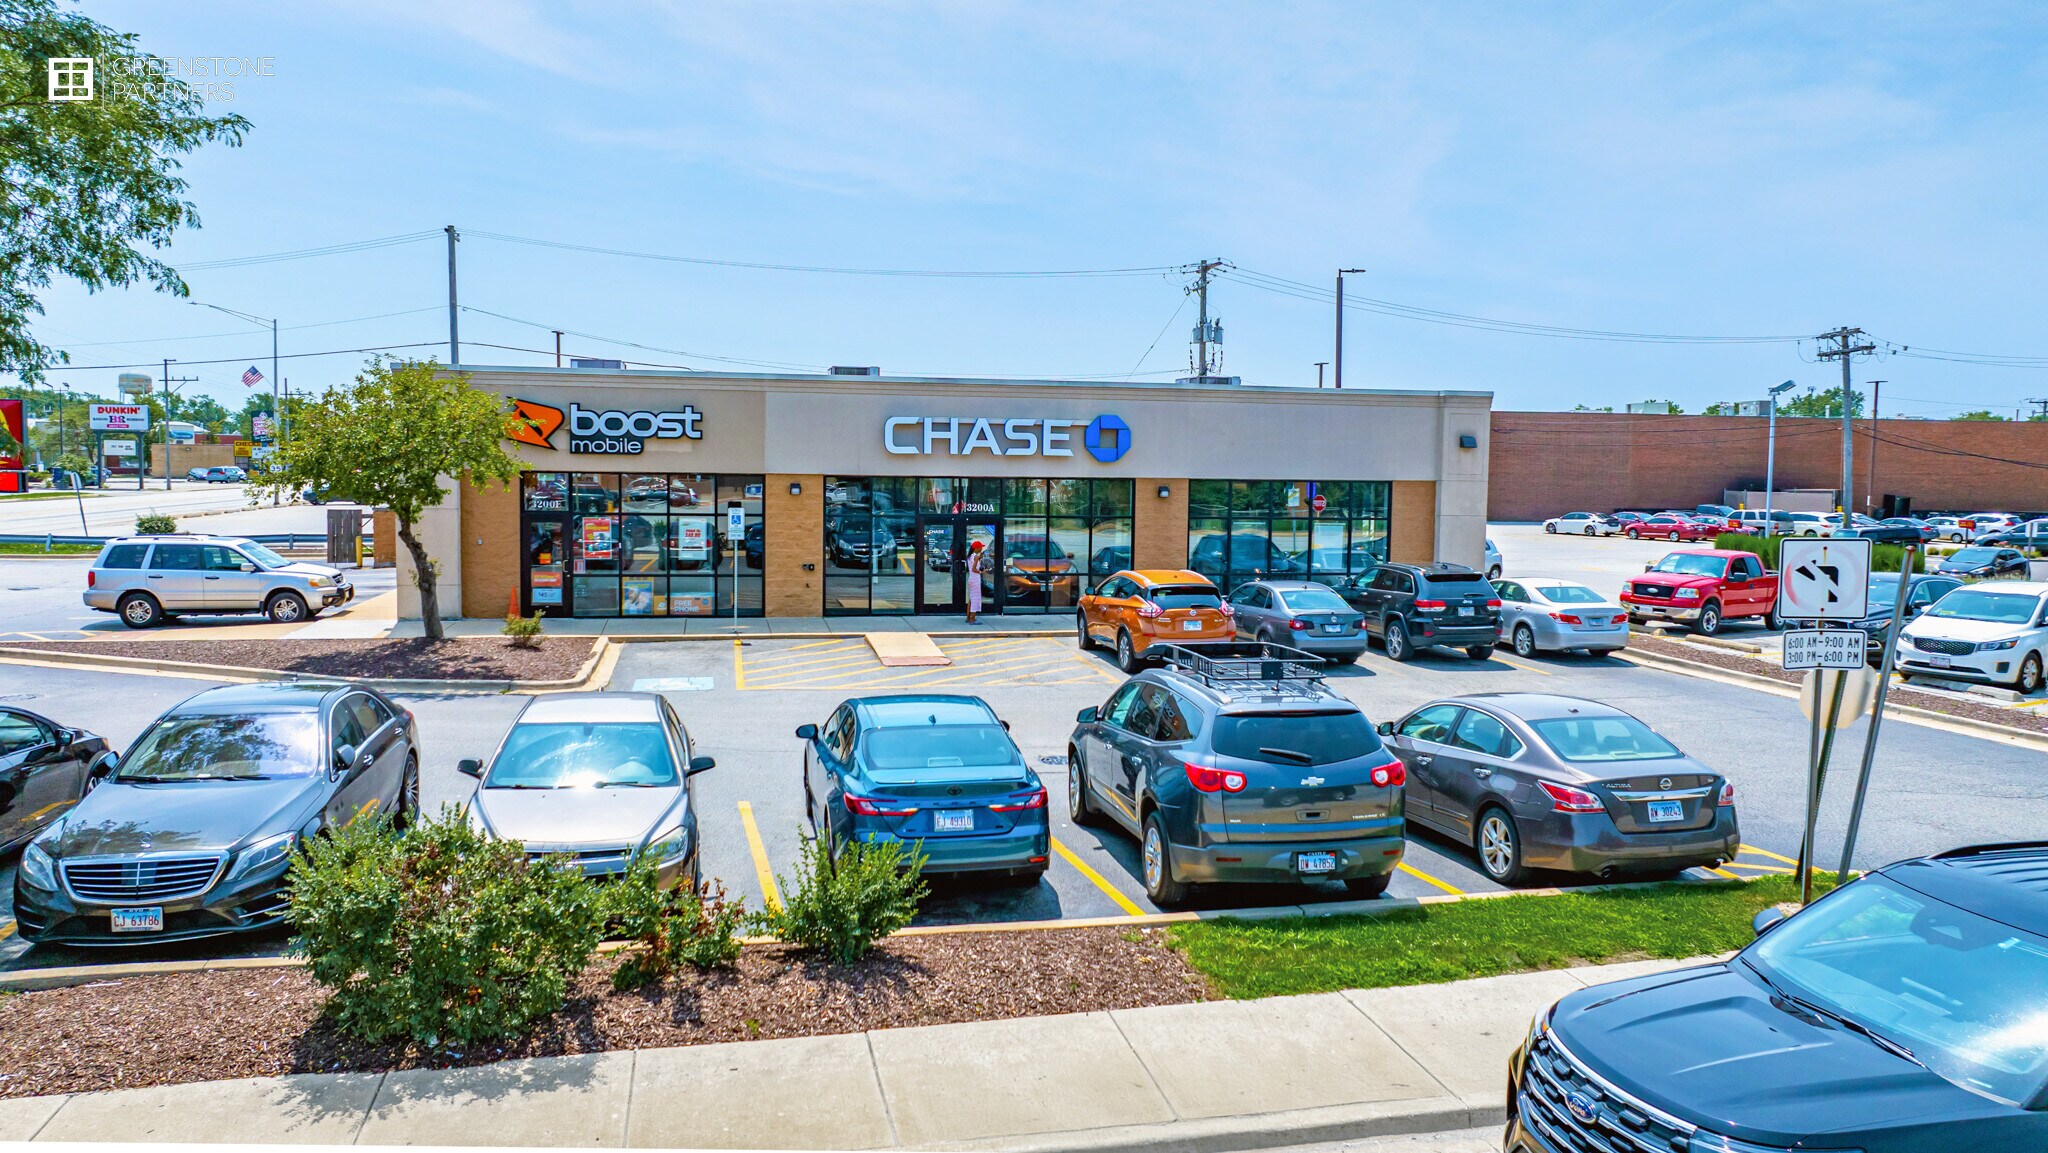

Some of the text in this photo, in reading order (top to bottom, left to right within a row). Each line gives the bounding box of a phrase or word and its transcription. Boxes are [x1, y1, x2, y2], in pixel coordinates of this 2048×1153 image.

[97, 406, 140, 414] DUNKIN'
[570, 403, 702, 439] boost
[884, 416, 1075, 457] CHASE
[571, 438, 642, 453] mobile
[966, 503, 995, 512] 3200A
[1788, 637, 1804, 649] 6:00
[1847, 637, 1860, 649] AM
[1788, 652, 1803, 663] 3:00
[1847, 651, 1859, 662] PM
[114, 915, 160, 926] CJ 63786
